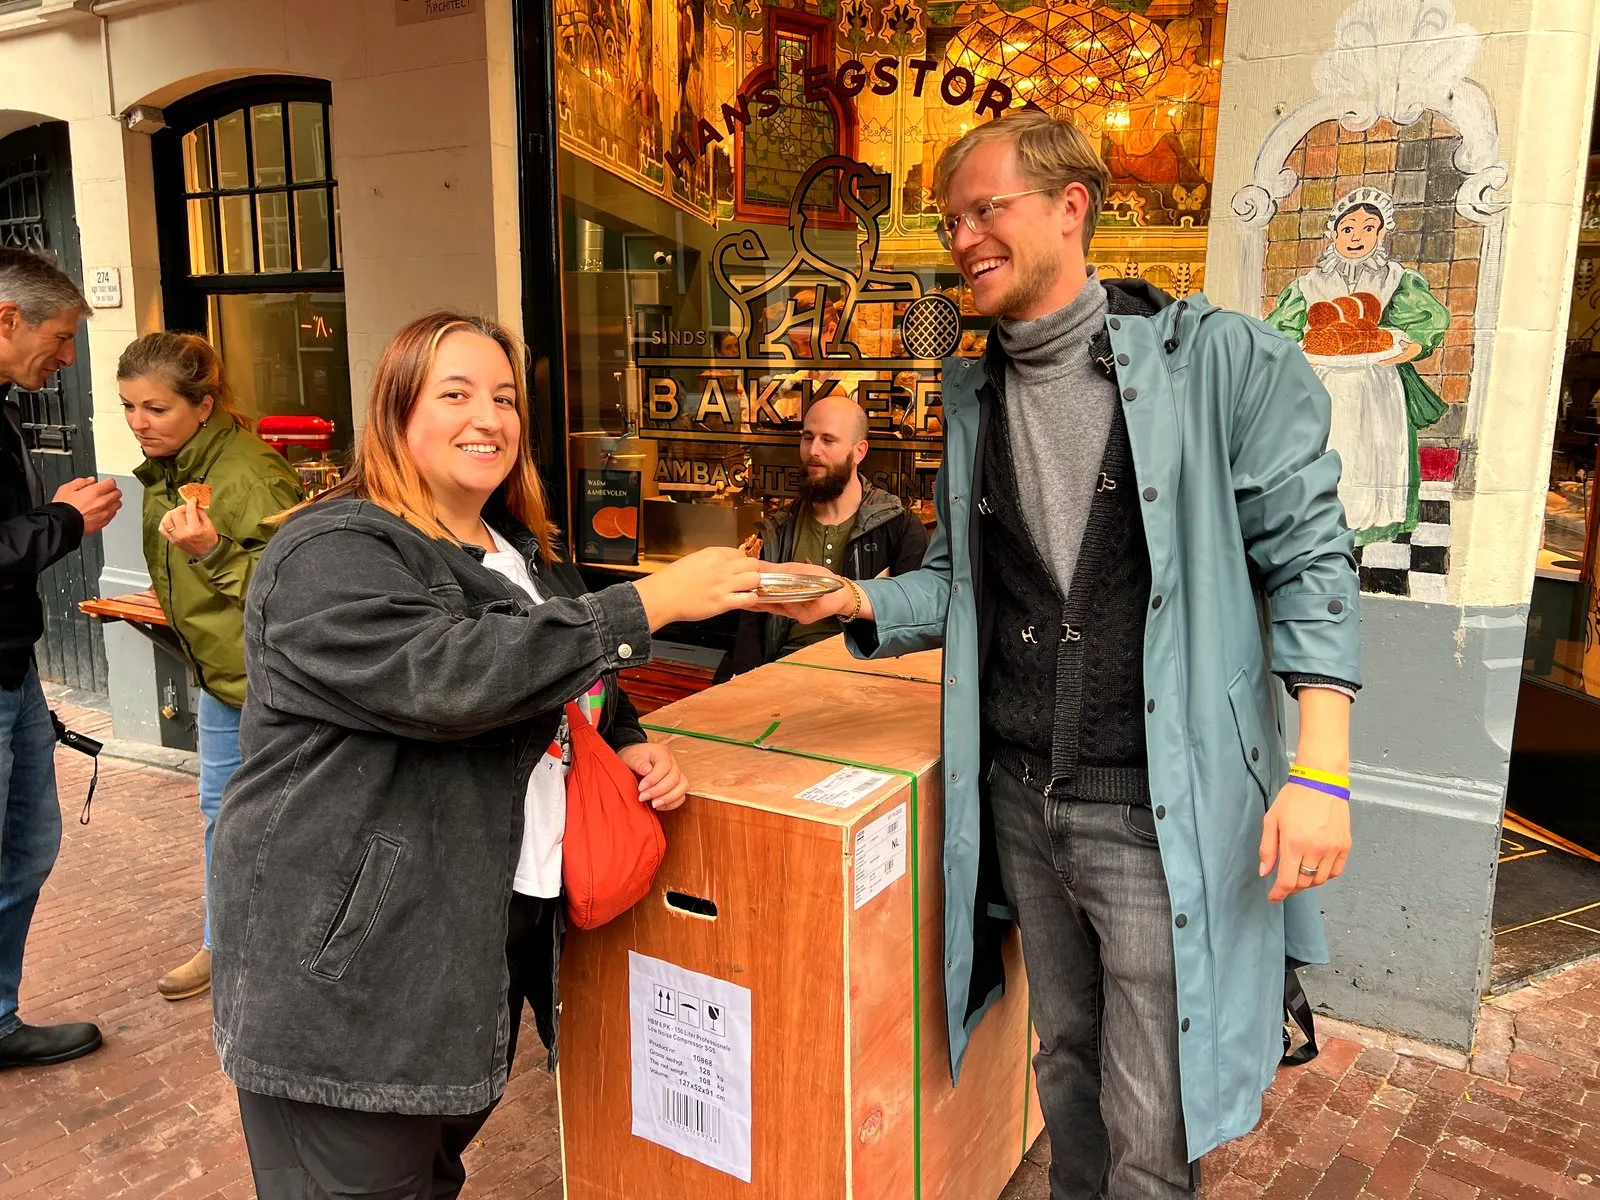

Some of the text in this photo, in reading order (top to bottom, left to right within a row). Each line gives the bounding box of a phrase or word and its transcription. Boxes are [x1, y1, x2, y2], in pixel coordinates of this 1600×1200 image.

[664, 58, 1049, 179] HANS EGSTOR
[96, 271, 110, 284] 274
[651, 329, 707, 345] SINDS
[586, 488, 628, 497] AANBEVOLEN
[587, 479, 606, 487] WARM
[891, 837, 900, 850] NL
[647, 1017, 659, 1026] HBM
[684, 1030, 696, 1039] Liter
[673, 1033, 704, 1049] Compressor
[649, 1038, 669, 1052] Product
[693, 1054, 713, 1067] 10868
[649, 1048, 665, 1059] Gross
[699, 1066, 711, 1076] 128
[716, 1073, 724, 1082] kg
[649, 1057, 659, 1067] The
[660, 1062, 669, 1070] net
[699, 1076, 711, 1086] 108
[716, 1083, 725, 1092] kg
[679, 1078, 714, 1097] 127x52x91
[716, 1094, 726, 1102] cm
